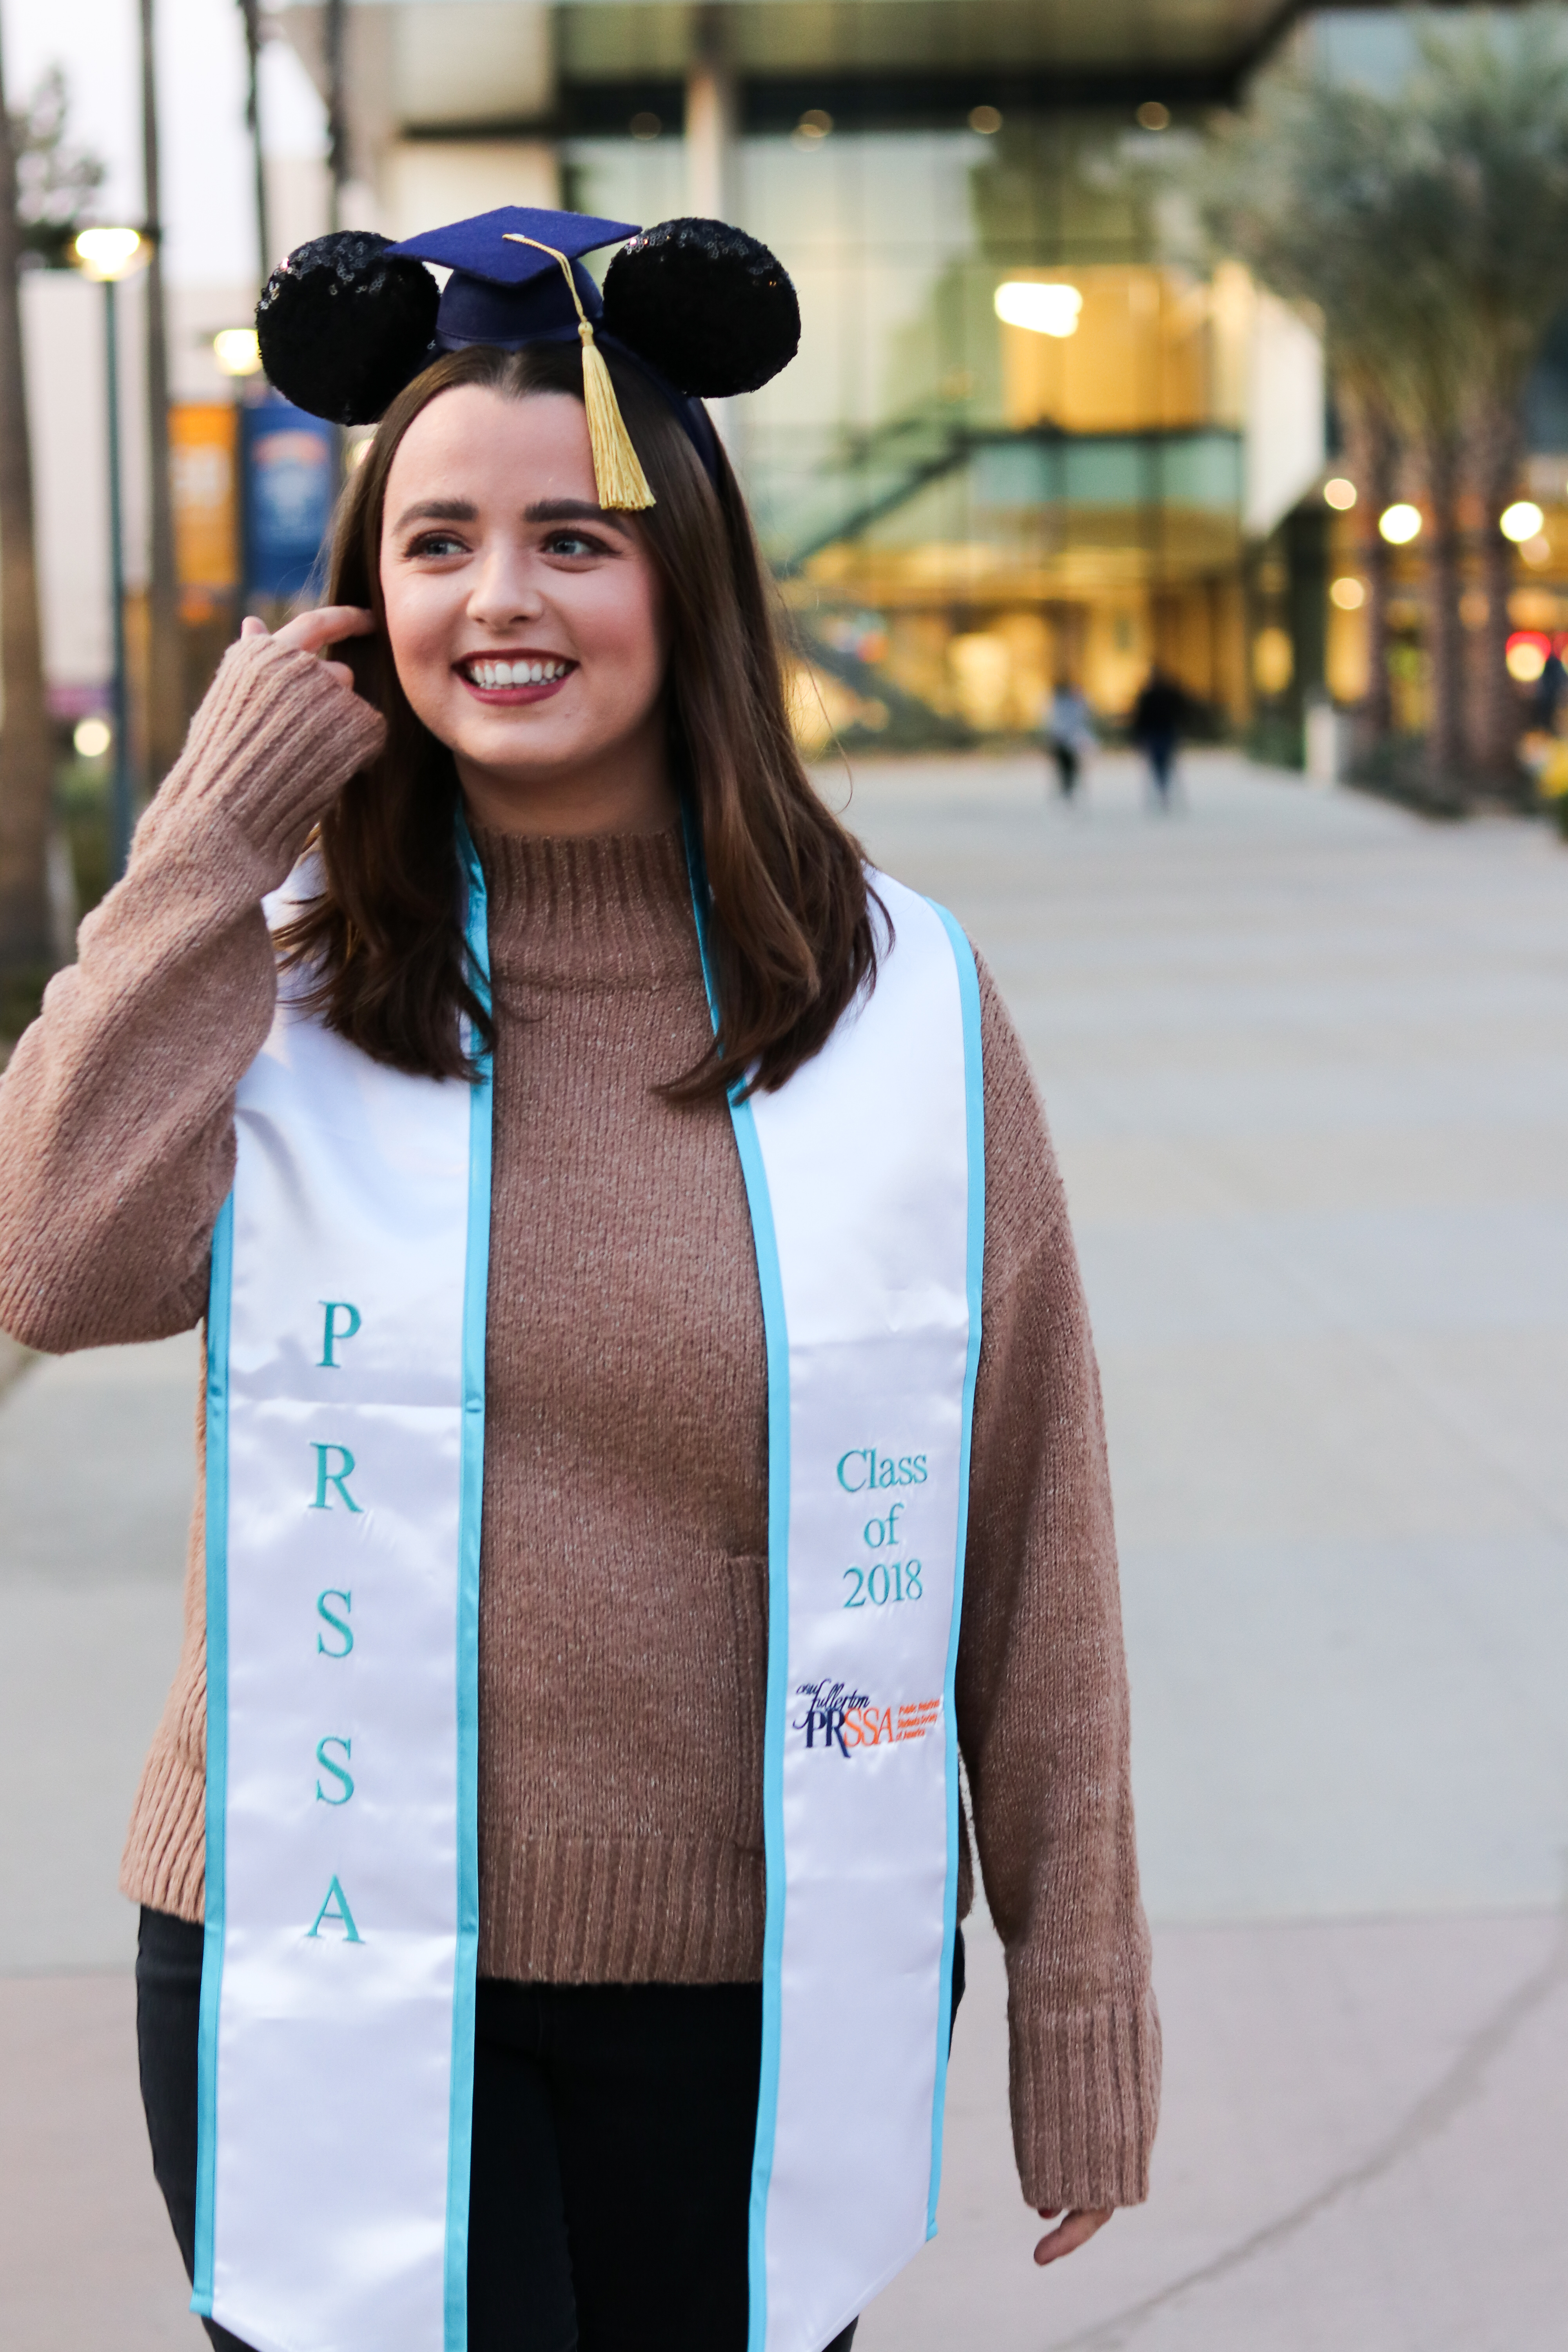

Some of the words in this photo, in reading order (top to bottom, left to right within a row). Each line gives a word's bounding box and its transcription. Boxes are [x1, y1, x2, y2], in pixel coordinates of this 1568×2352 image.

[837, 1448, 927, 1492] Class
[863, 1503, 904, 1548] of
[843, 1559, 923, 1608] 2018
[806, 1706, 895, 1758] PRSSA
